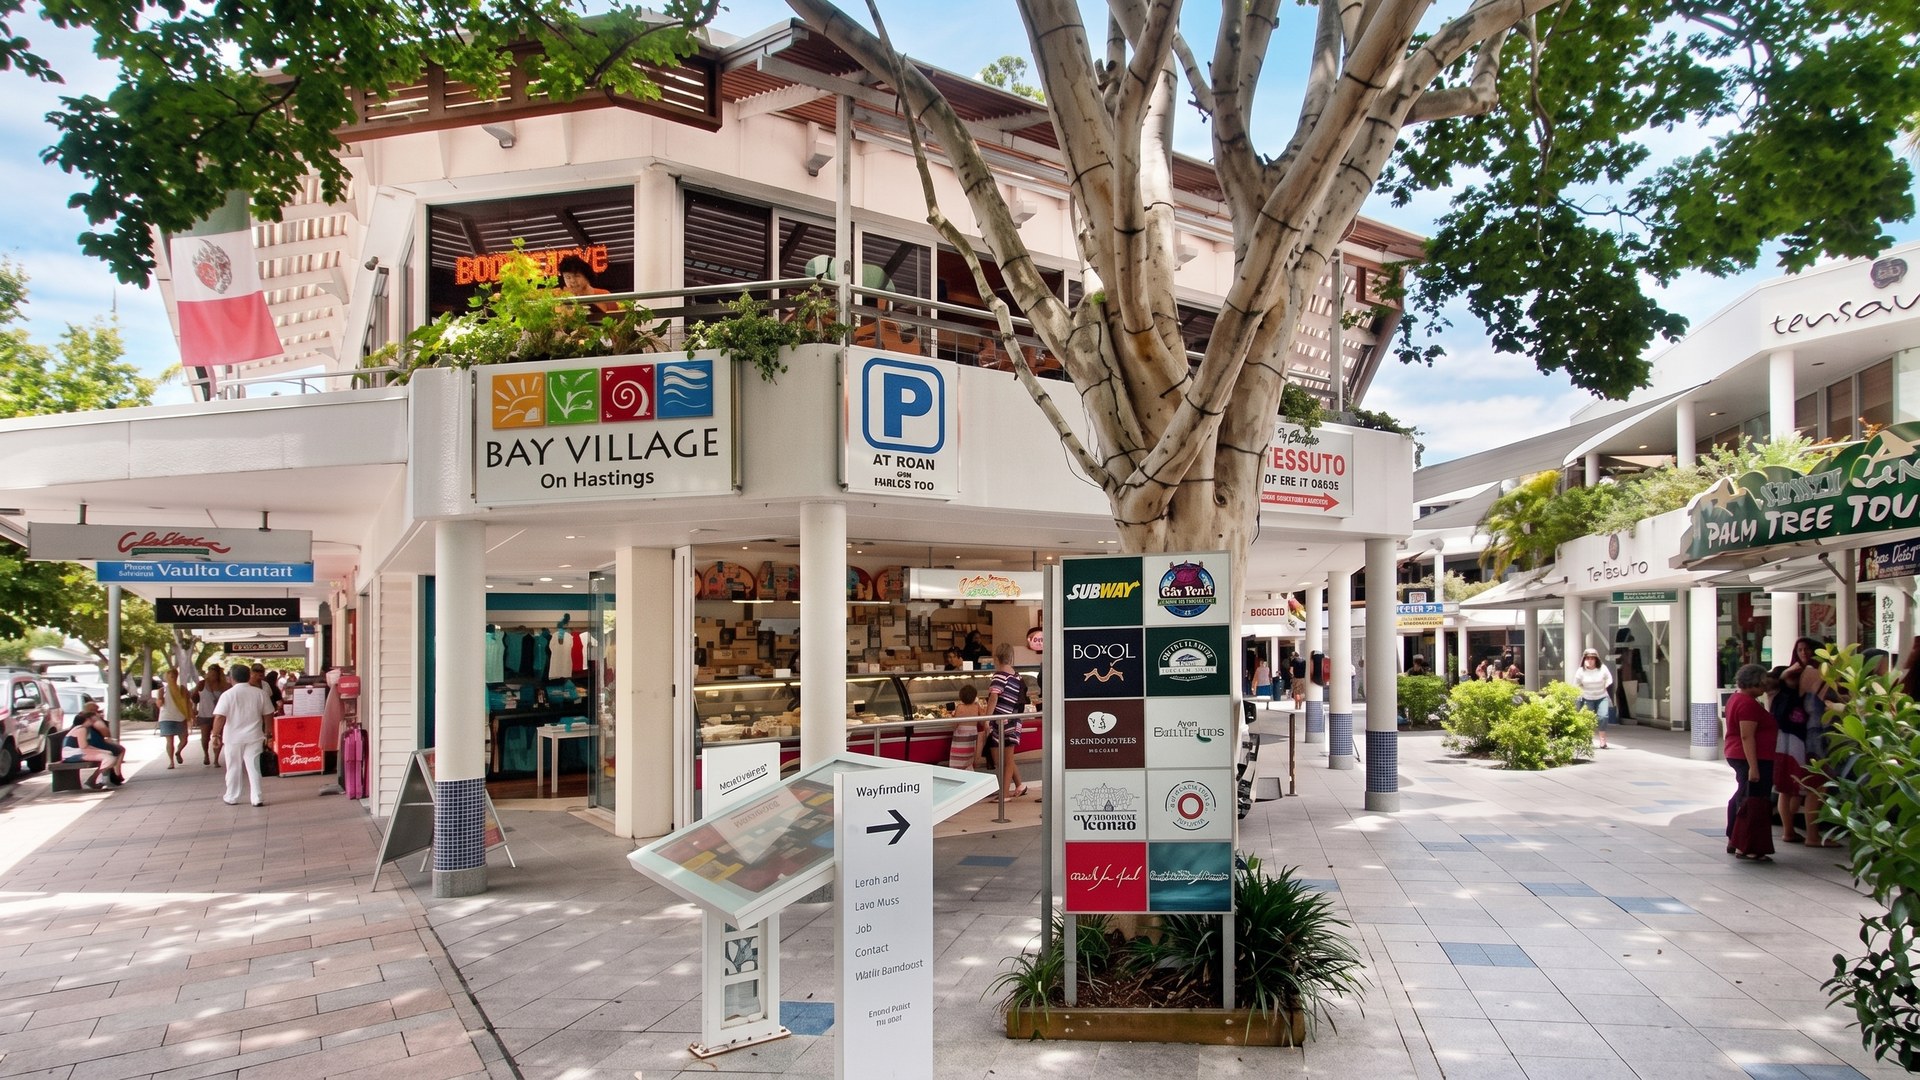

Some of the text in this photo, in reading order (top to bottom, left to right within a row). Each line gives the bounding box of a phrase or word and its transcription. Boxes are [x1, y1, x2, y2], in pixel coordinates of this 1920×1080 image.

[486, 428, 719, 468] BAY VILLAGE
[873, 453, 935, 470] AT ROAN
[541, 470, 655, 490] On Hastings
[914, 480, 934, 490] TOO
[1280, 475, 1296, 486] ERE
[1706, 493, 1920, 549] PALM TREE TOU
[1066, 581, 1140, 600] SUBWAY
[173, 604, 287, 616] Wealth Dulance
[882, 873, 900, 884] and
[877, 897, 900, 908] Muss
[855, 923, 872, 935] Job
[855, 944, 889, 958] Contact
